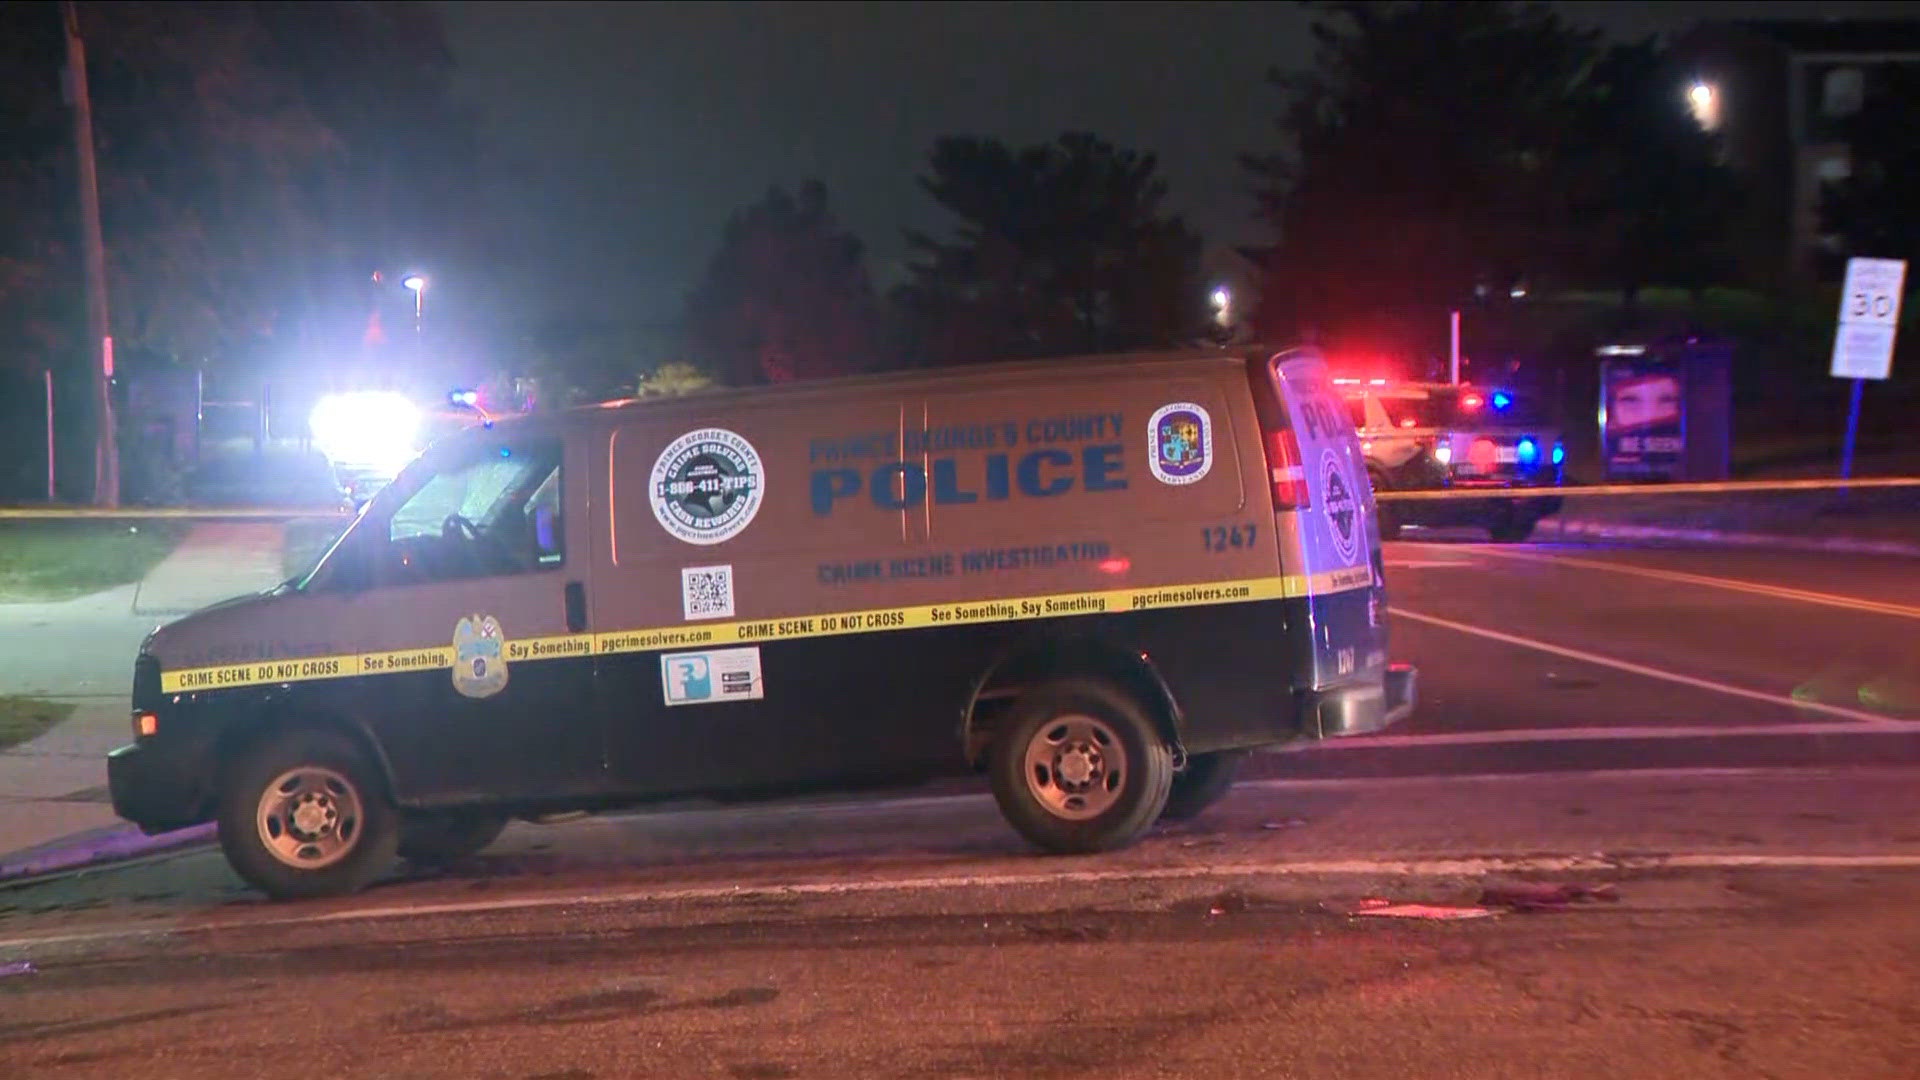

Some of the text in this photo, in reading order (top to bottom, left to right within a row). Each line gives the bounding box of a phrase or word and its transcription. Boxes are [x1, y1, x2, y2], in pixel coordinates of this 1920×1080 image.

[1851, 293, 1891, 317] 30
[1026, 412, 1124, 444] COUNTY
[657, 441, 685, 473] PRINCE
[668, 445, 701, 479] CRIME
[810, 445, 1129, 516] POLICE
[669, 495, 746, 528] CASH REWARDS
[1203, 525, 1257, 551] 1247
[818, 560, 882, 585] CRIME
[889, 552, 956, 578] SCENE
[931, 596, 1106, 622] See Something, Say Something
[1132, 585, 1249, 608] pgcrimesolvers.com
[738, 611, 905, 640] CRIME SCENE DO NOT CROSS
[510, 641, 530, 658] Say
[532, 637, 591, 655] Something
[601, 631, 712, 651] pgcrimesolvers.com
[179, 660, 339, 688] CRIME SCENE DO NOT CROSS
[364, 656, 385, 670] See
